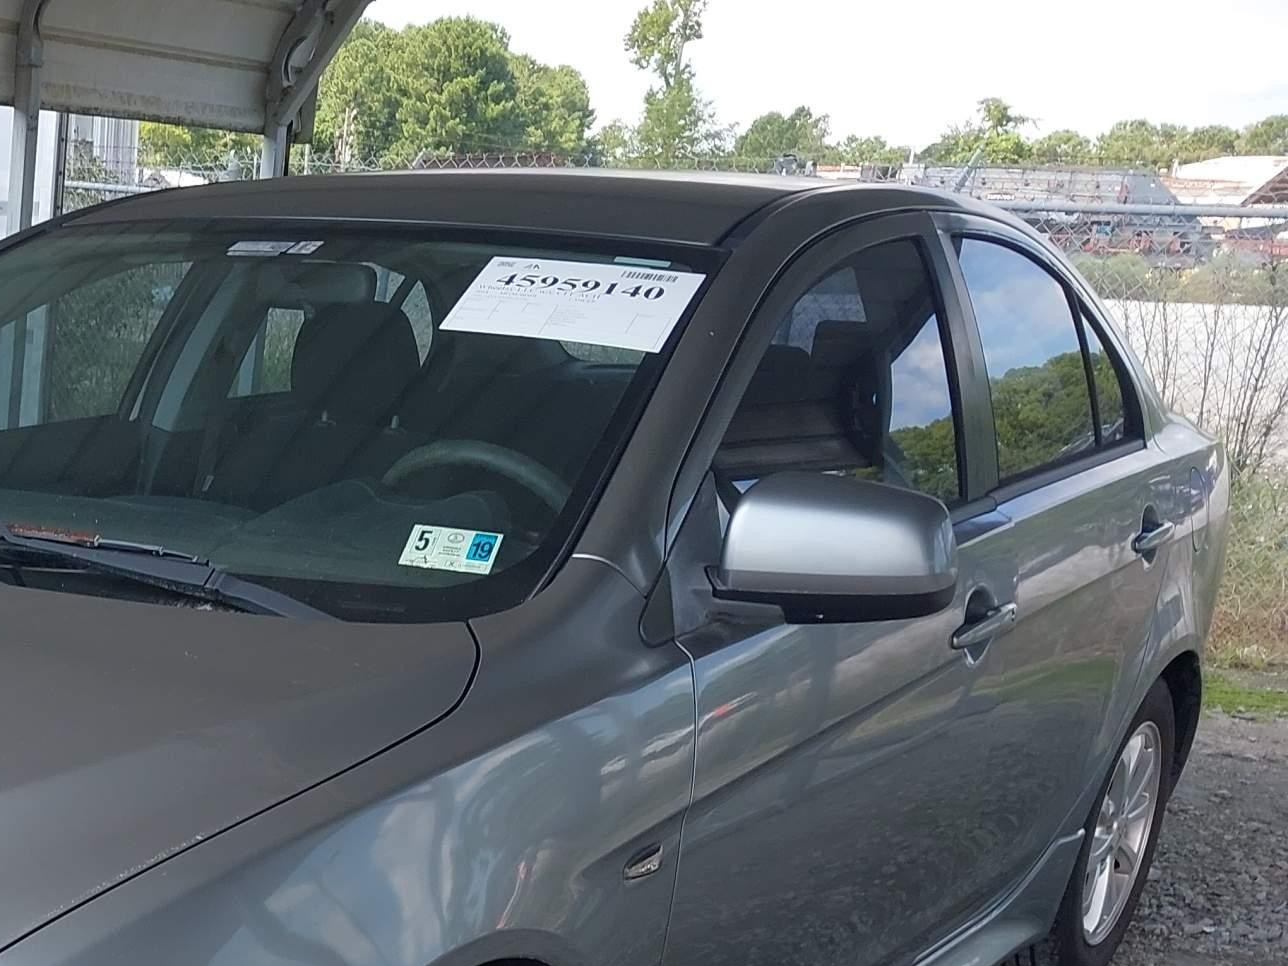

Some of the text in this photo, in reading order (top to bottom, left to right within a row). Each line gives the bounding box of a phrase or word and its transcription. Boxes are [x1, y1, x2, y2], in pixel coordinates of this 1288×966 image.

[496, 273, 666, 301] 45959140
[415, 530, 434, 551] 5
[472, 541, 493, 559] 19
